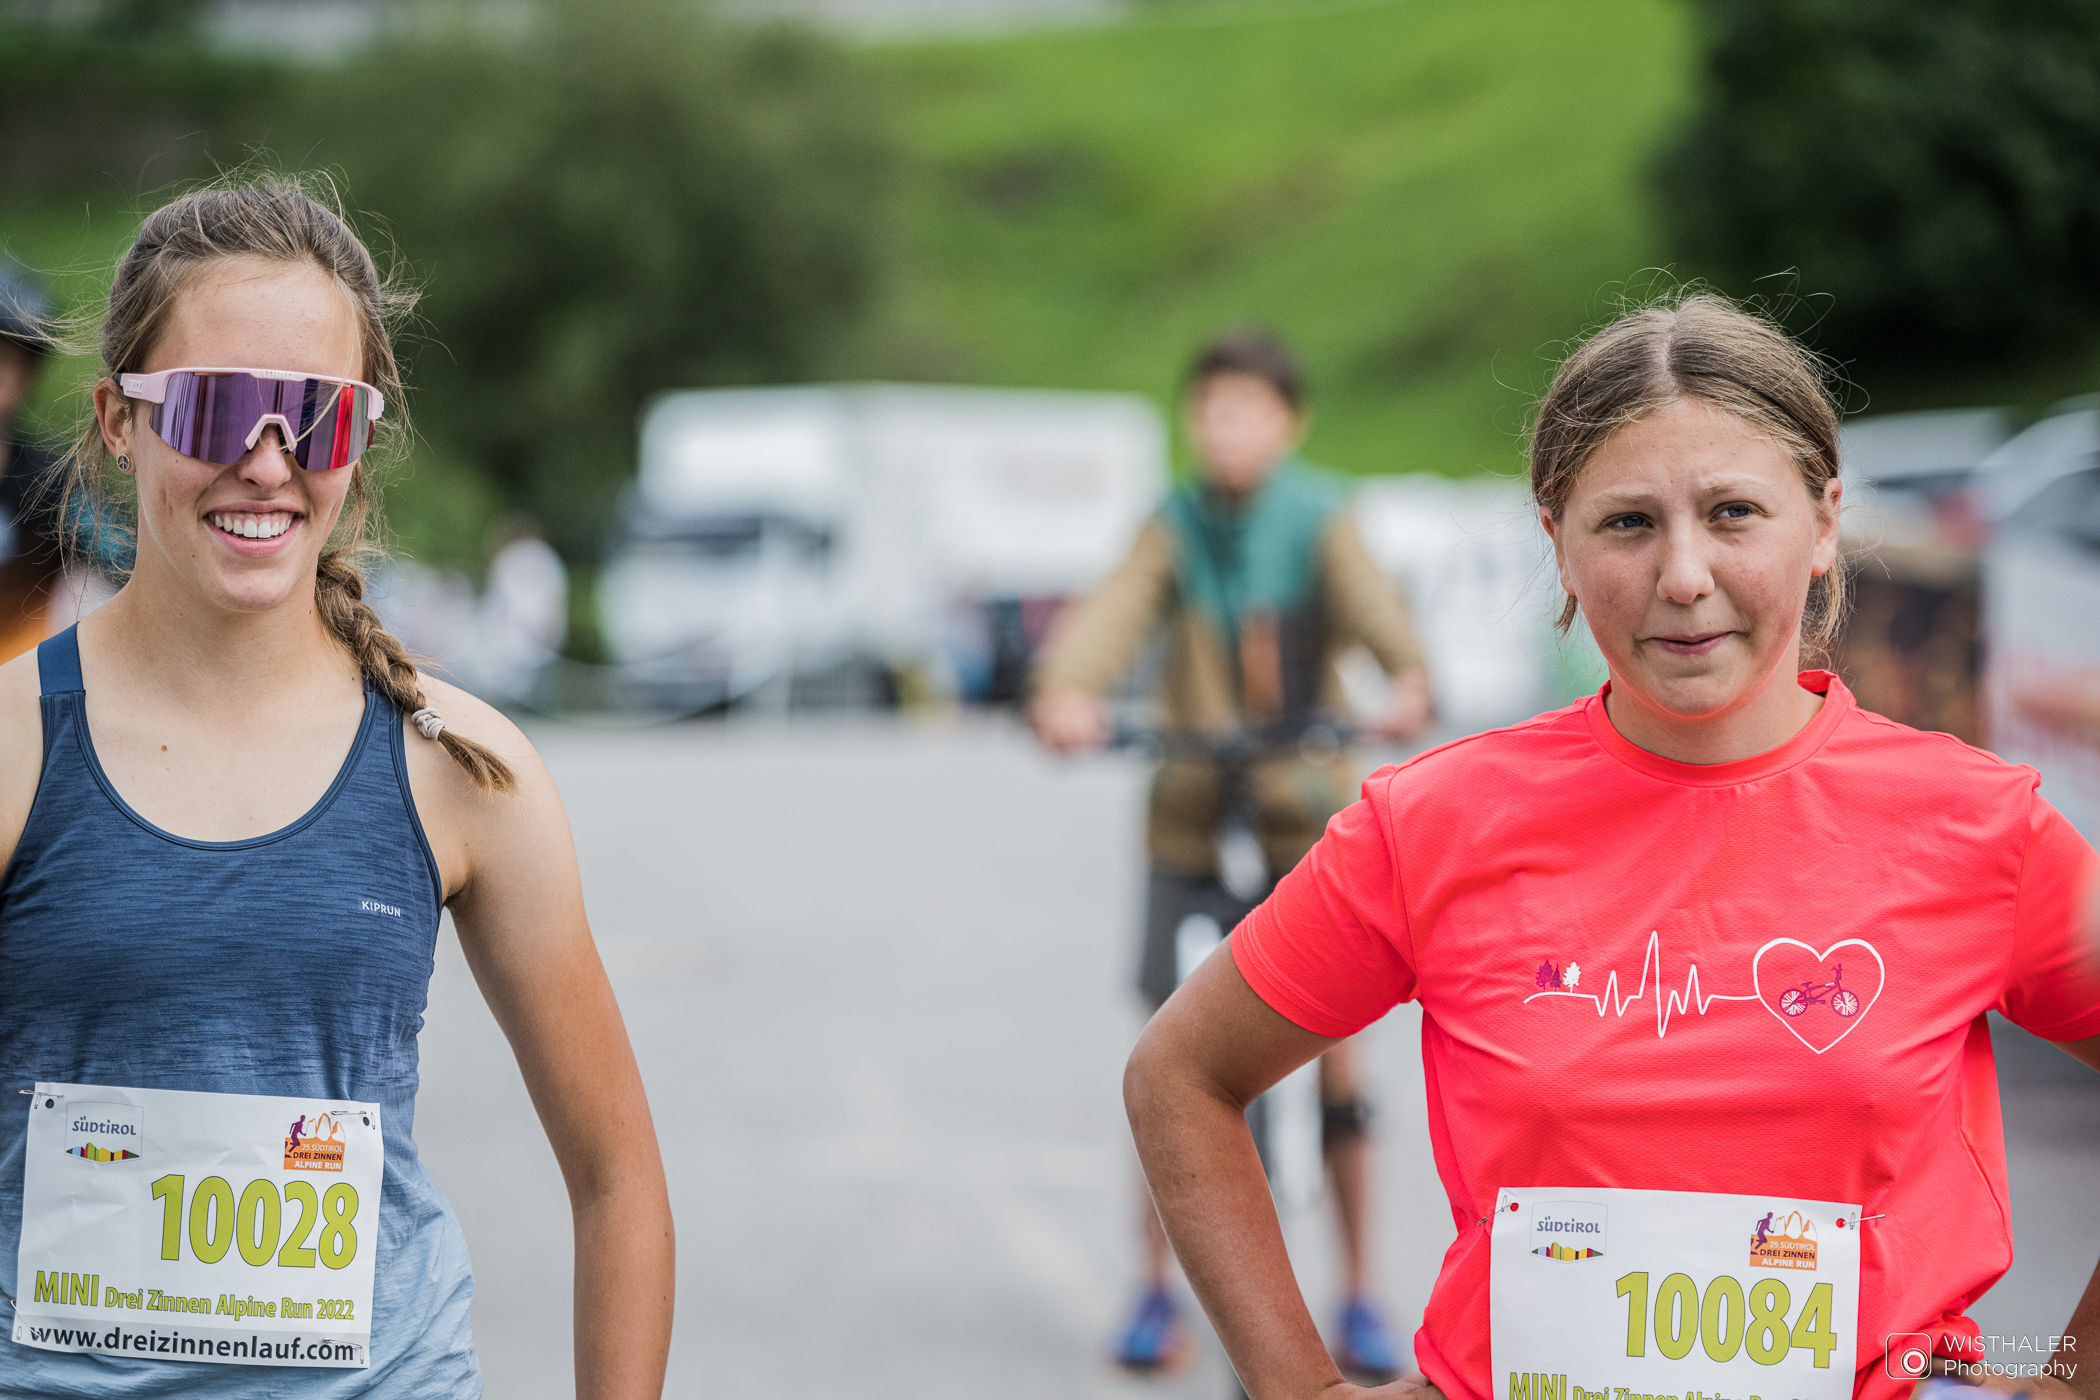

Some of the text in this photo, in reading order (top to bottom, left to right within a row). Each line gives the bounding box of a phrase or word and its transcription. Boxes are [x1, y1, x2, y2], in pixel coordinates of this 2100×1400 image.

[361, 900, 401, 918] KIPRUN
[293, 1151, 343, 1161] DREI ZINNEN
[294, 1160, 342, 1170] ALPINE RUN
[151, 1174, 359, 1270] 10028
[1760, 1248, 1816, 1260] DREI ZINNEN
[1761, 1257, 1816, 1269] ALPINE RUN
[34, 1270, 354, 1321] MINI Drei Zinnen Alpine Run 2022
[1615, 1271, 1837, 1369] 10084
[30, 1326, 355, 1361] www.dreizinnenlauf.com
[1509, 1372, 1567, 1400] MINI
